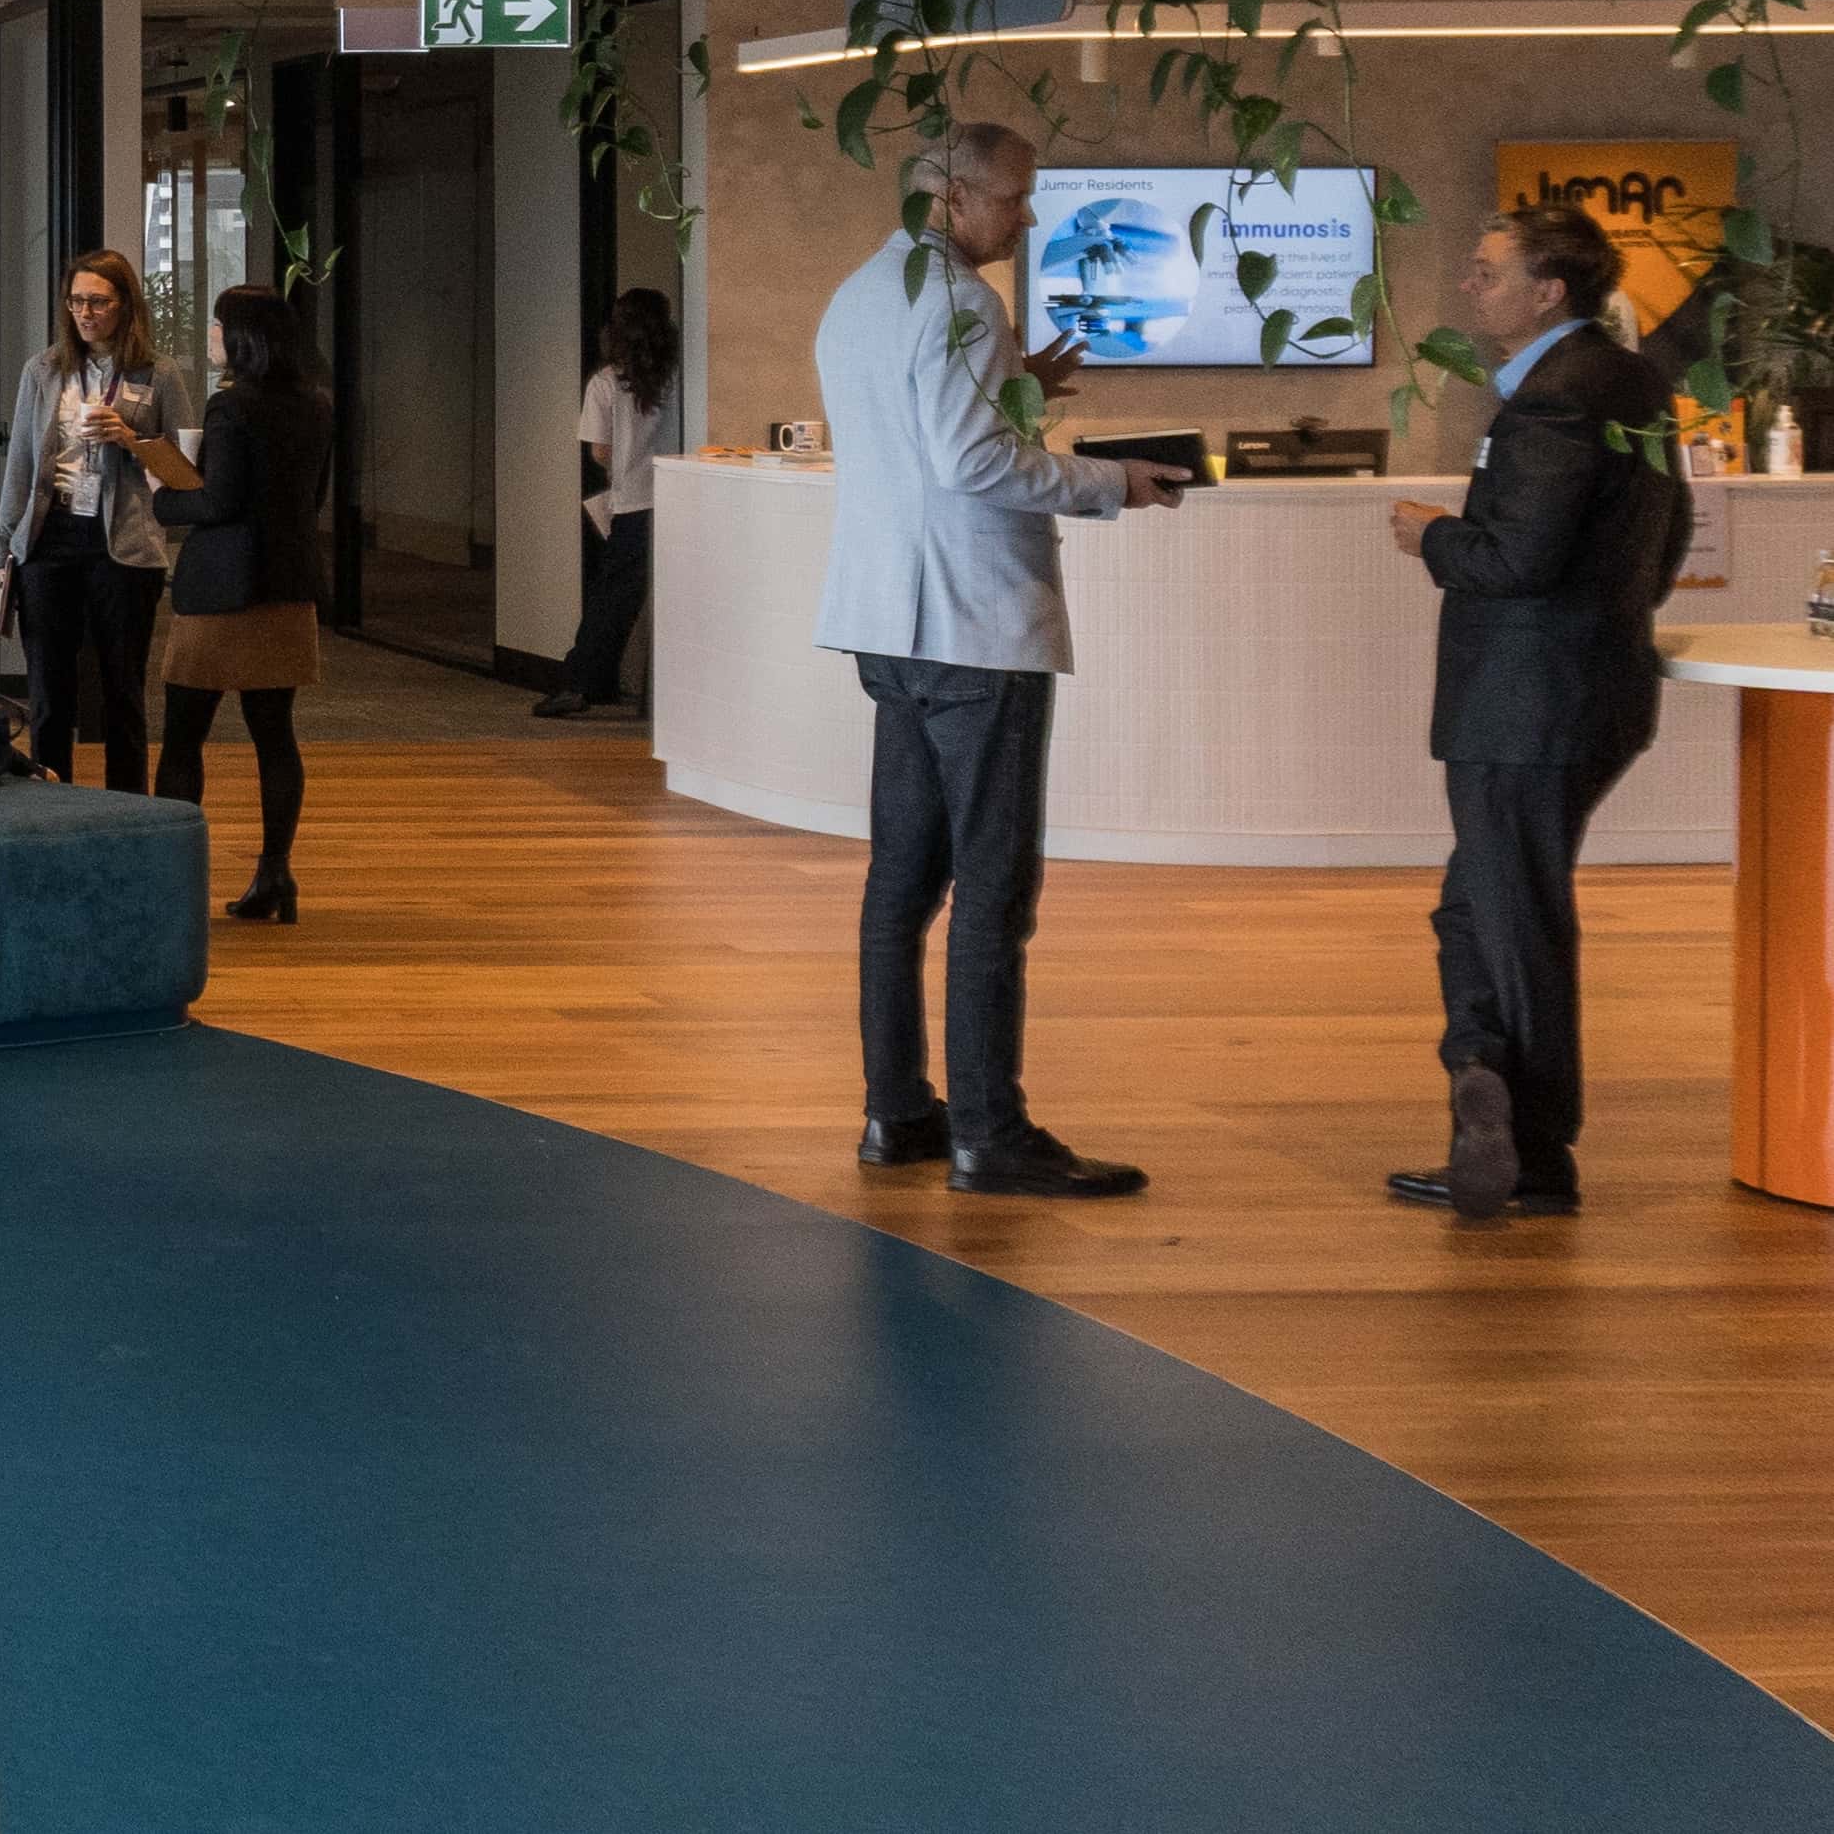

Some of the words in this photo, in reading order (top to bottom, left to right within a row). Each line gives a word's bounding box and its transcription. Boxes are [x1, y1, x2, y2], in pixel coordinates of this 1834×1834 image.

[1040, 178, 1084, 191] Jumar
[1086, 178, 1154, 191] Residents
[1221, 217, 1352, 238] immunosis
[1287, 252, 1309, 263] the
